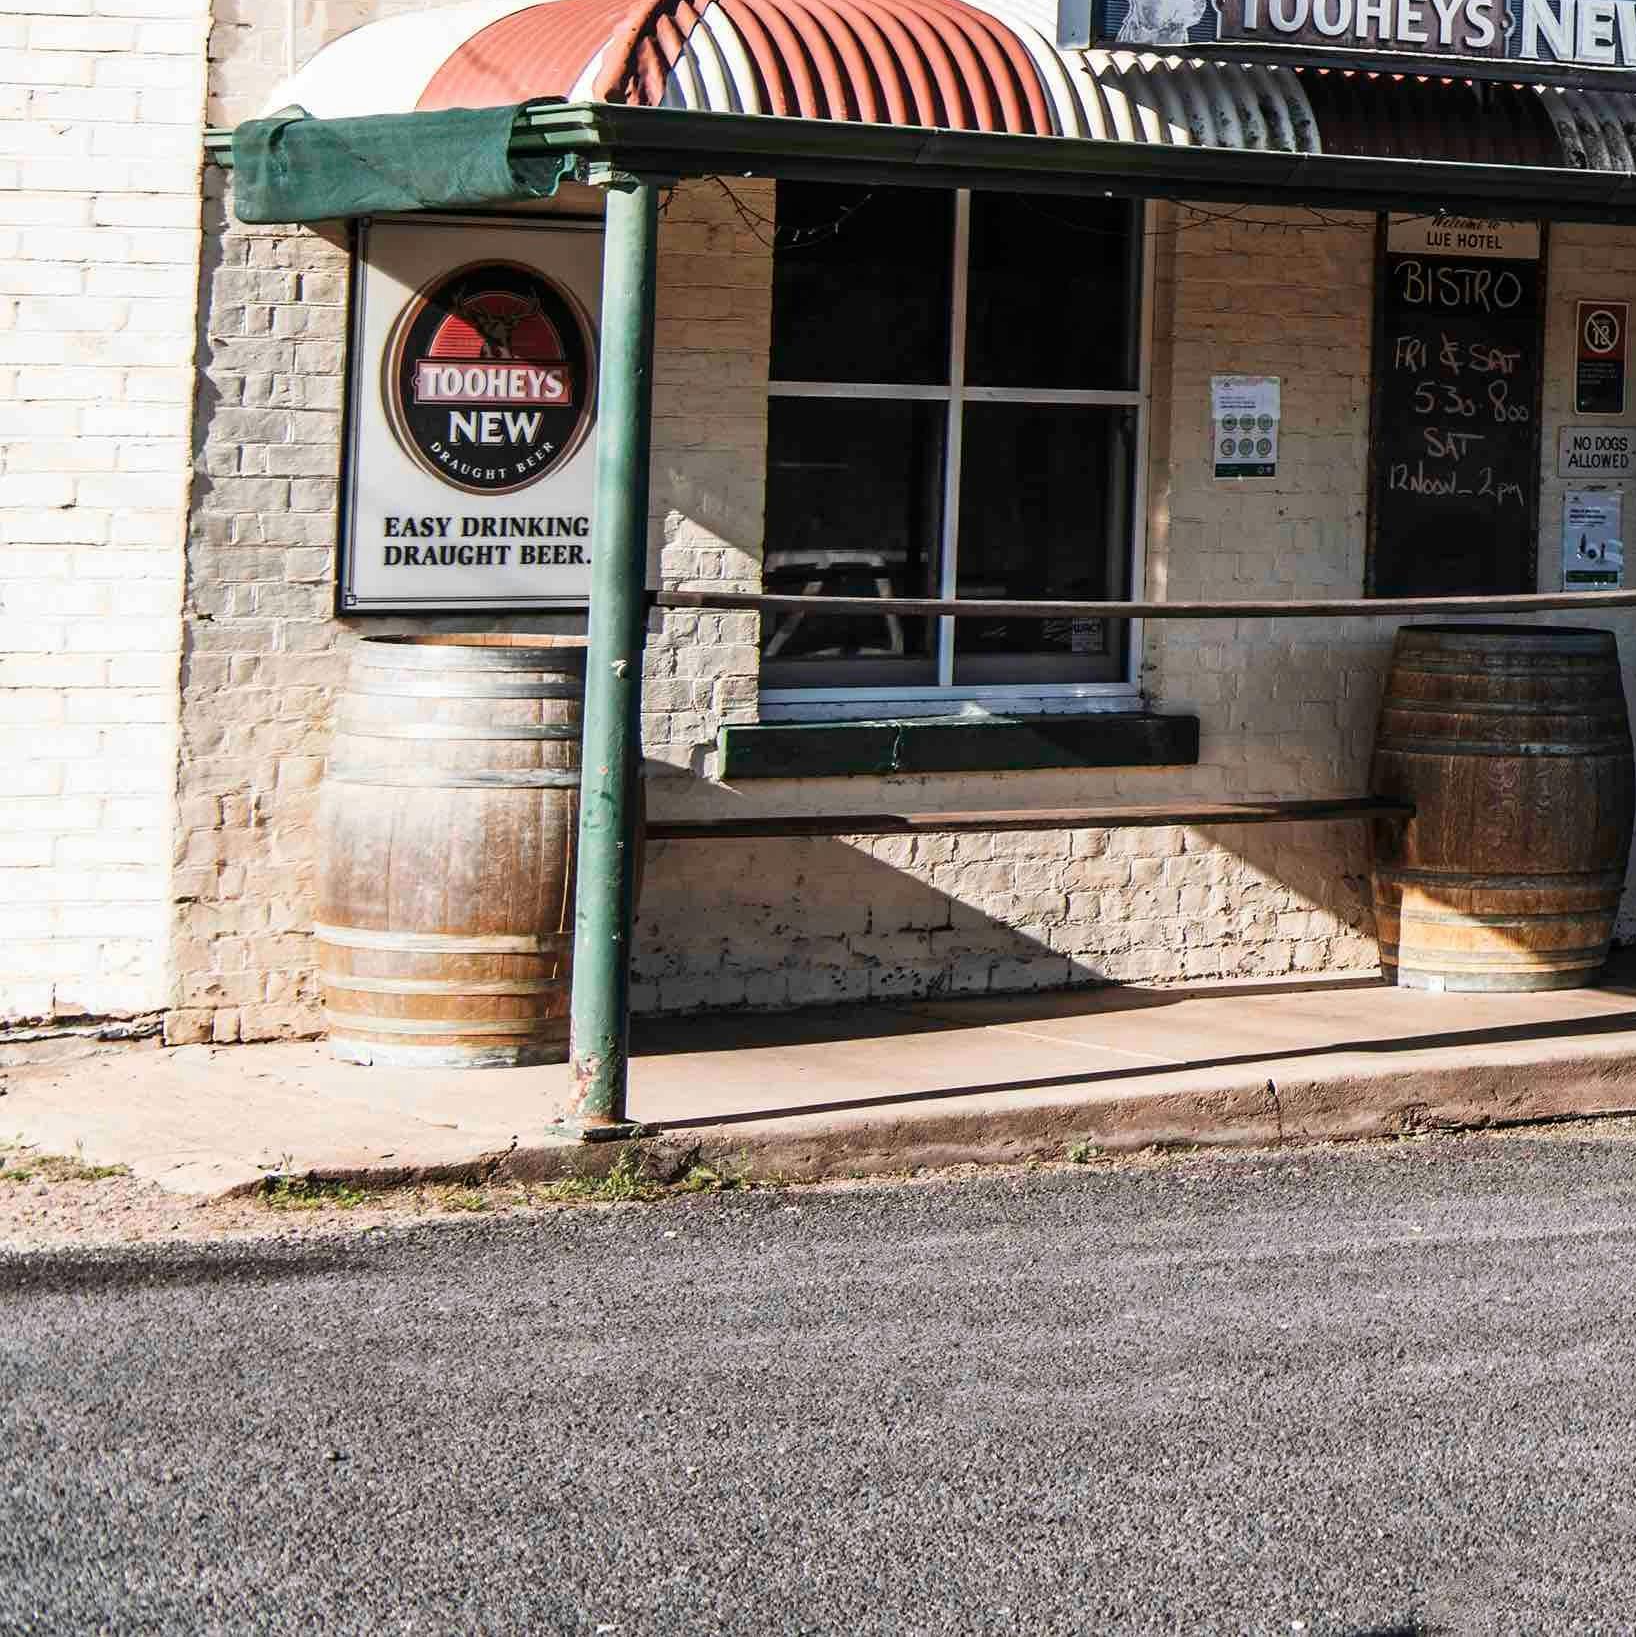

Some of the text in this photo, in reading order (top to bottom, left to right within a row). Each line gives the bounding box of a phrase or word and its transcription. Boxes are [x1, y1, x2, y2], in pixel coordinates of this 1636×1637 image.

[1427, 231, 1504, 251] LUE HOTEL
[1395, 259, 1524, 313] BISTRO
[1393, 334, 1429, 374] FRI
[1468, 342, 1522, 375] SAT
[421, 366, 566, 400] TOOHEYS
[448, 410, 544, 447] NEW
[1423, 425, 1486, 461] SAT
[1574, 435, 1629, 452] NO DOGS
[429, 441, 556, 480] DRAUGHT BEER
[1568, 452, 1630, 469] ALLOWED
[384, 515, 589, 540] EASY DRINKING
[384, 544, 593, 567] DRAUGHT BEER.
